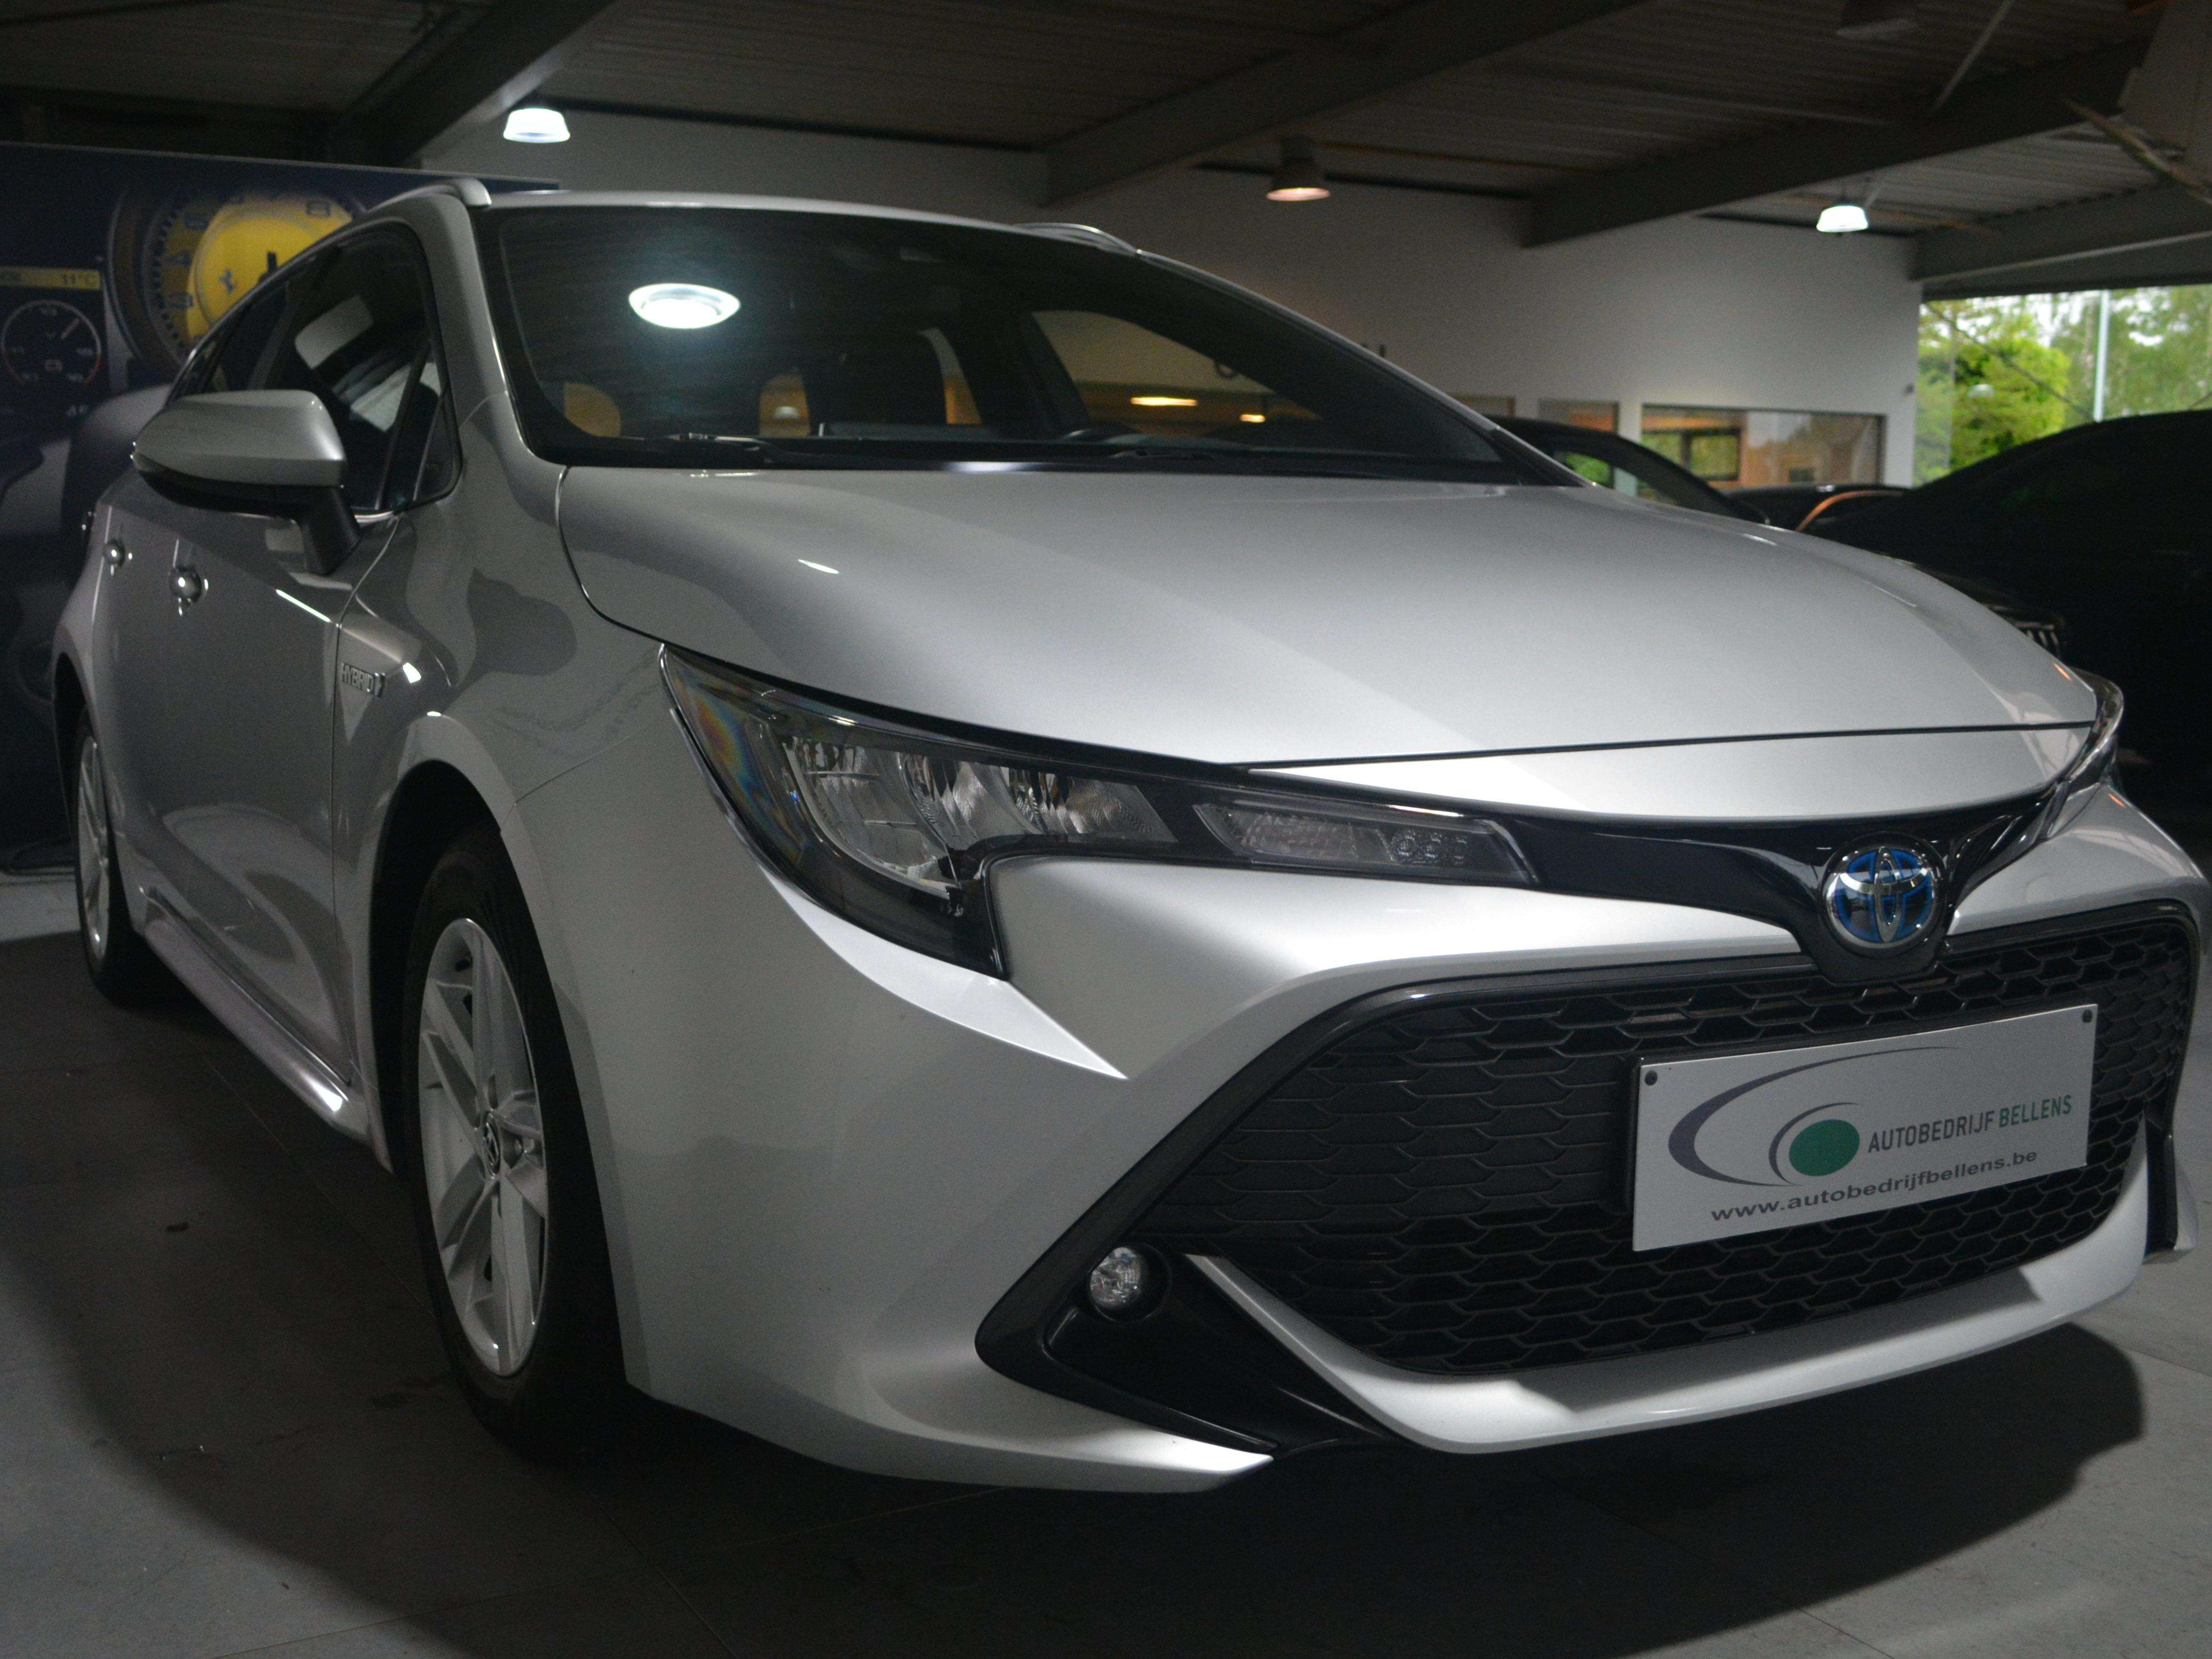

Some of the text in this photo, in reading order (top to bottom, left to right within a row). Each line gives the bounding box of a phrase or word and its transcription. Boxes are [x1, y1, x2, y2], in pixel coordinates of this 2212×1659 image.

[341, 663, 374, 693] HYBRID
[1868, 1094, 2072, 1153] AUTOBEDRIJF BELLENS
[1711, 1151, 2037, 1221] www.autobedrijfbellens.be
